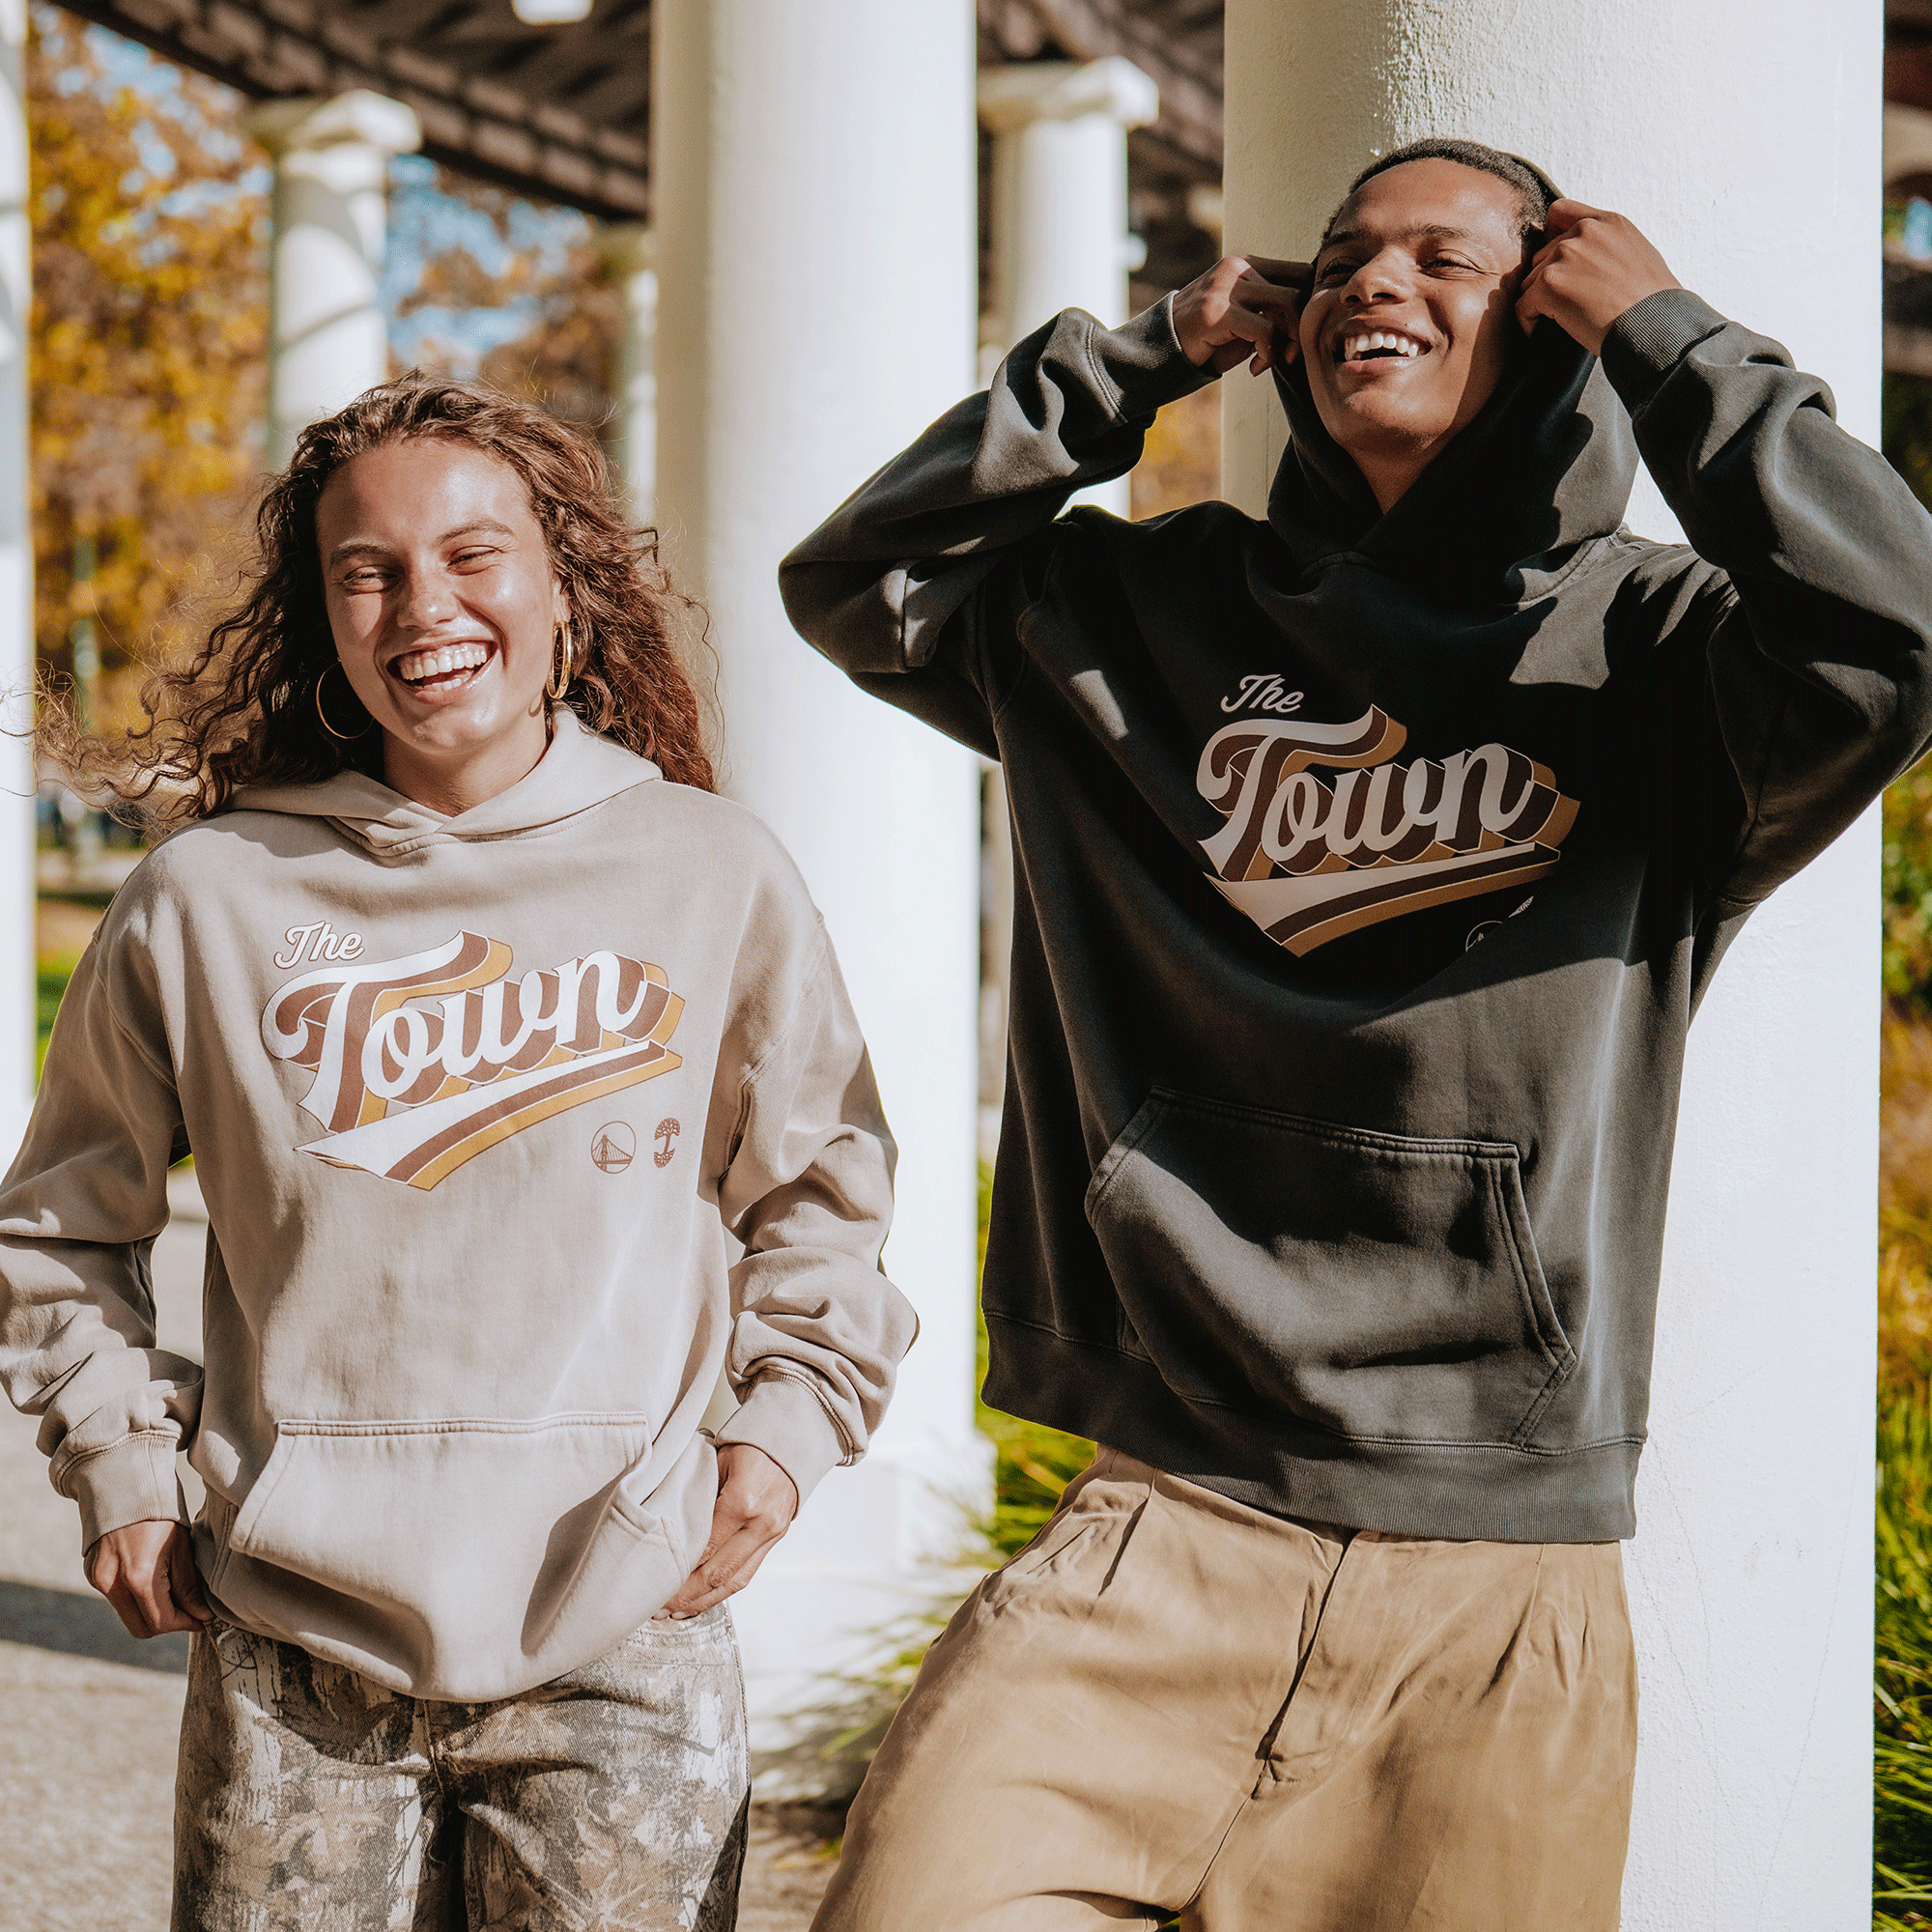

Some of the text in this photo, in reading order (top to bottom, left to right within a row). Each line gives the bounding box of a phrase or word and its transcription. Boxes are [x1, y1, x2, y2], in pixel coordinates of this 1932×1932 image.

[1221, 674, 1304, 713] The
[1197, 704, 1577, 881] Town
[274, 921, 365, 969] The
[262, 930, 680, 1133] Town
